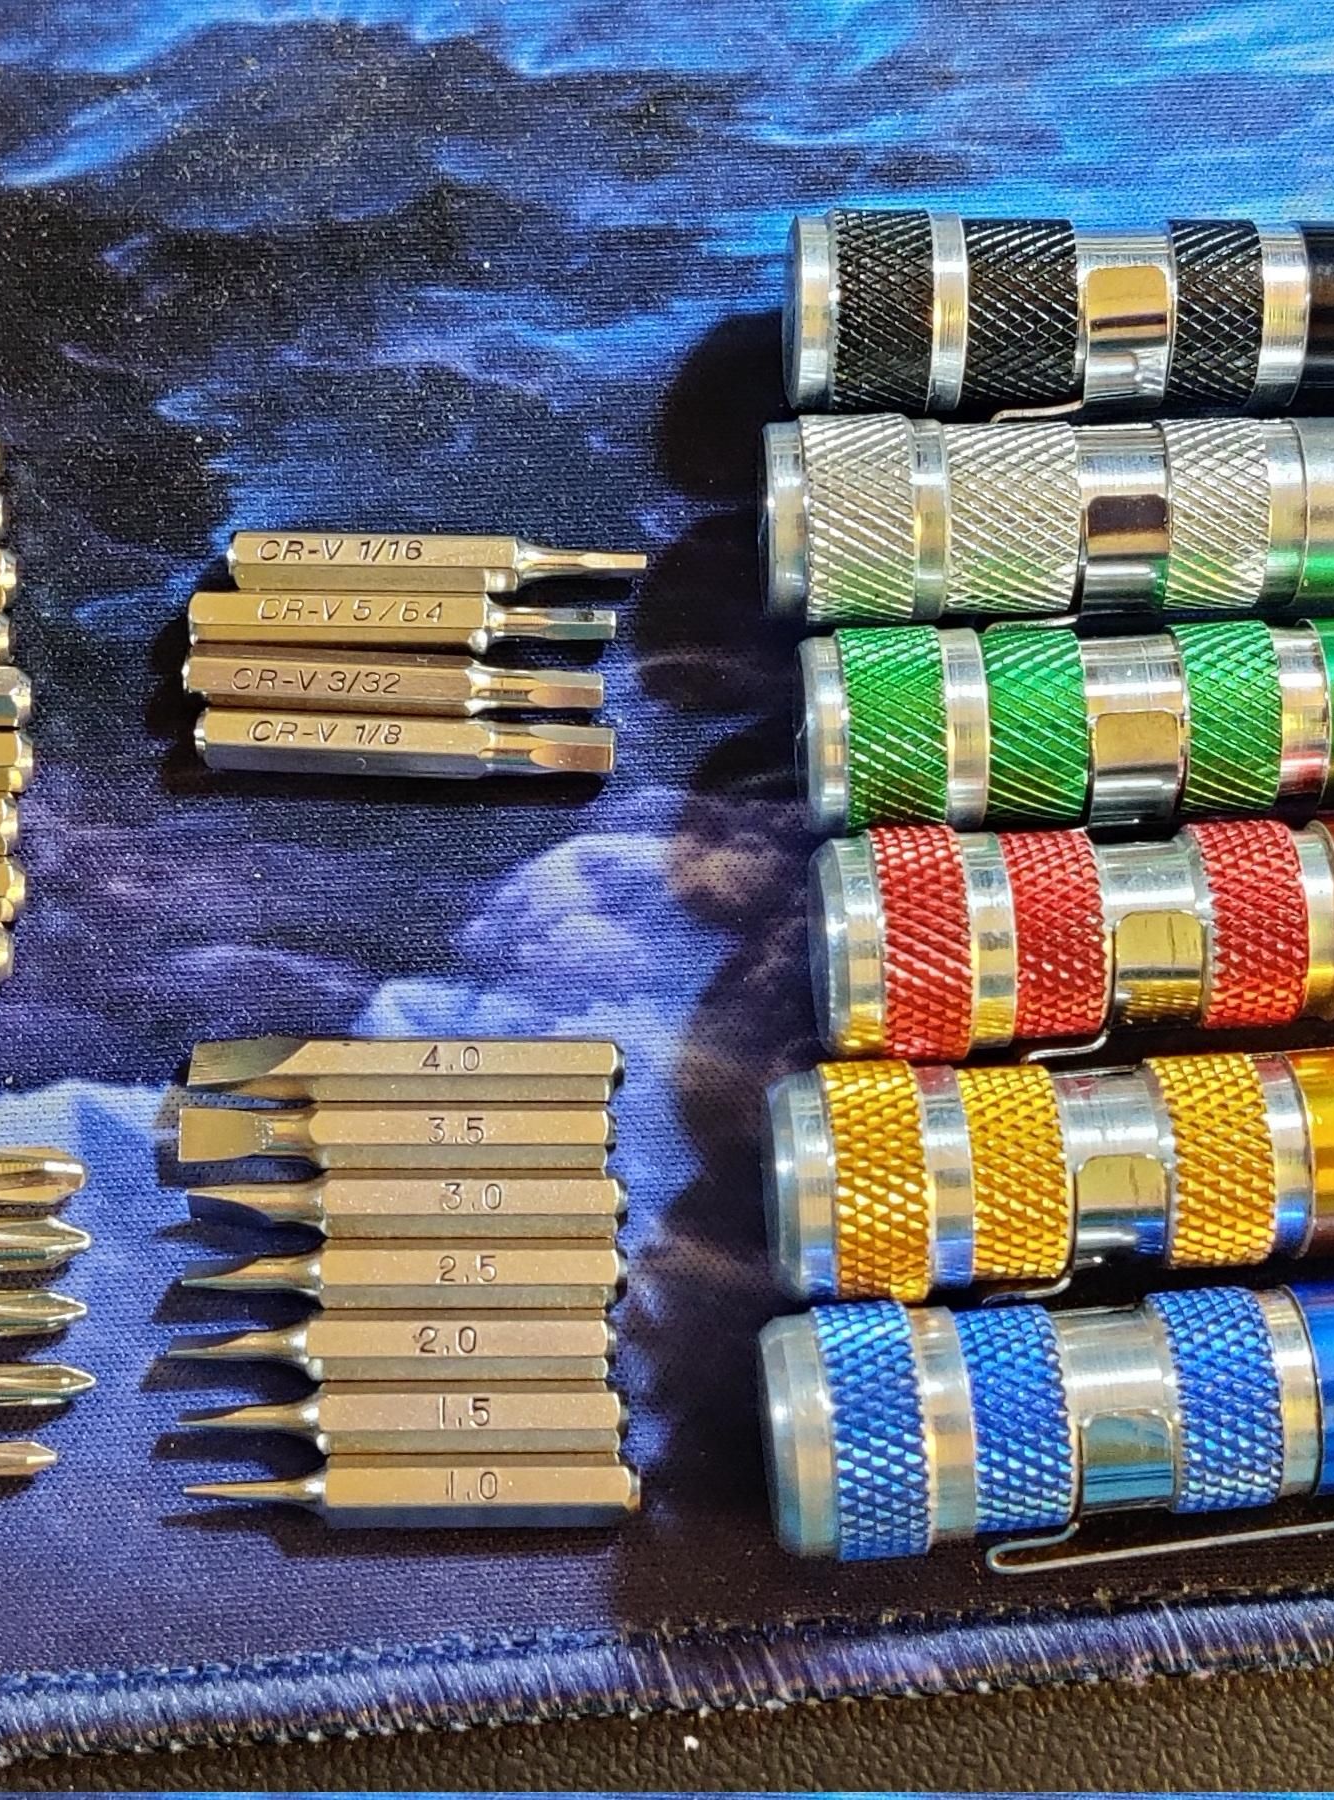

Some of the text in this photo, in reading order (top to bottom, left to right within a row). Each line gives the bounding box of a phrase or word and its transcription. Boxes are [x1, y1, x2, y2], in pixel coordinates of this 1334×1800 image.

[258, 540, 423, 561] CR-V 1/16
[257, 598, 344, 621] CR-V
[231, 668, 401, 695] CR-V 3/32
[247, 721, 402, 744] CR-V 1/8
[418, 1045, 481, 1072] 4.0
[426, 1117, 485, 1144] 3.5
[439, 1182, 502, 1211] 3.0
[435, 1255, 498, 1283] 2.5
[417, 1326, 478, 1355] 2.0
[435, 1396, 491, 1427] 1.5
[444, 1470, 498, 1501] 1.0
